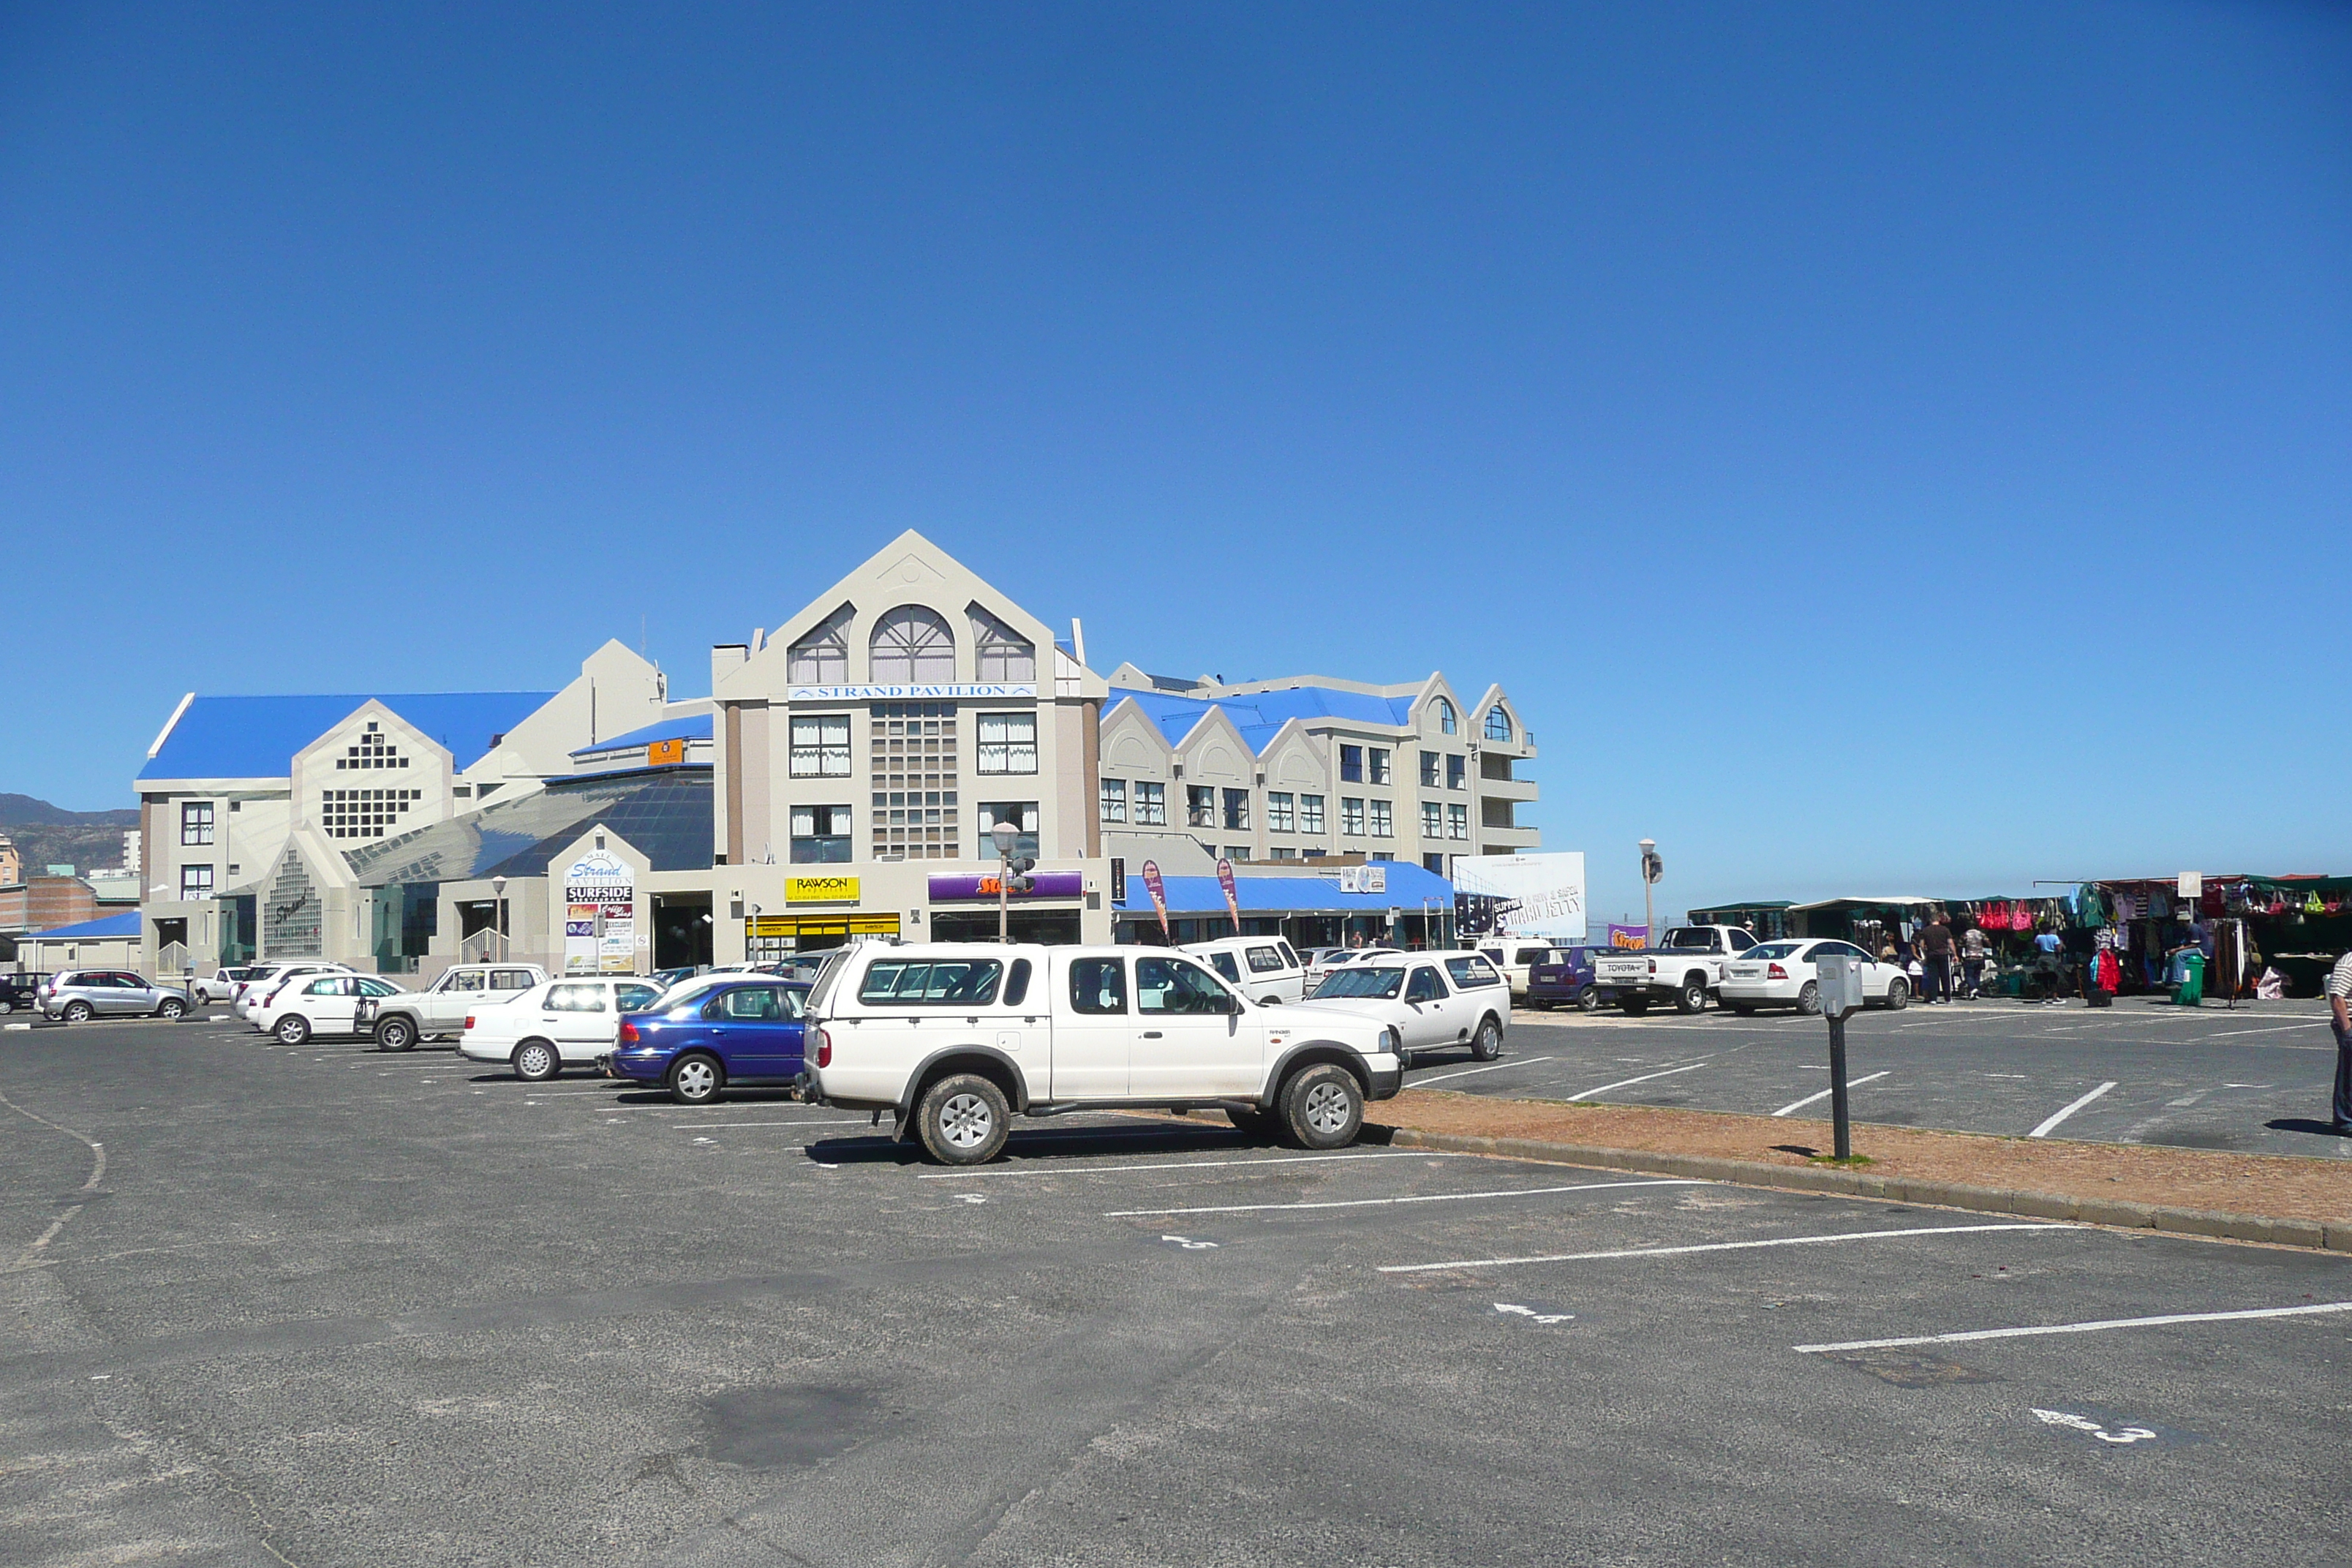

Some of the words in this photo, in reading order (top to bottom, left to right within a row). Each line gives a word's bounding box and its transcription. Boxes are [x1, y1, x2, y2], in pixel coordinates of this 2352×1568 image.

[818, 687, 902, 697] STRAND
[909, 685, 1006, 696] PAVILION
[571, 863, 623, 877] Strand
[567, 877, 632, 885] PAVILION
[796, 878, 848, 888] RAWSON
[569, 887, 630, 898] SURFSIDE
[1494, 897, 1523, 913] SUPPORT
[1496, 905, 1541, 927] STRAND
[1546, 897, 1580, 918] JETTY
[1607, 964, 1636, 972] TOYOTA
